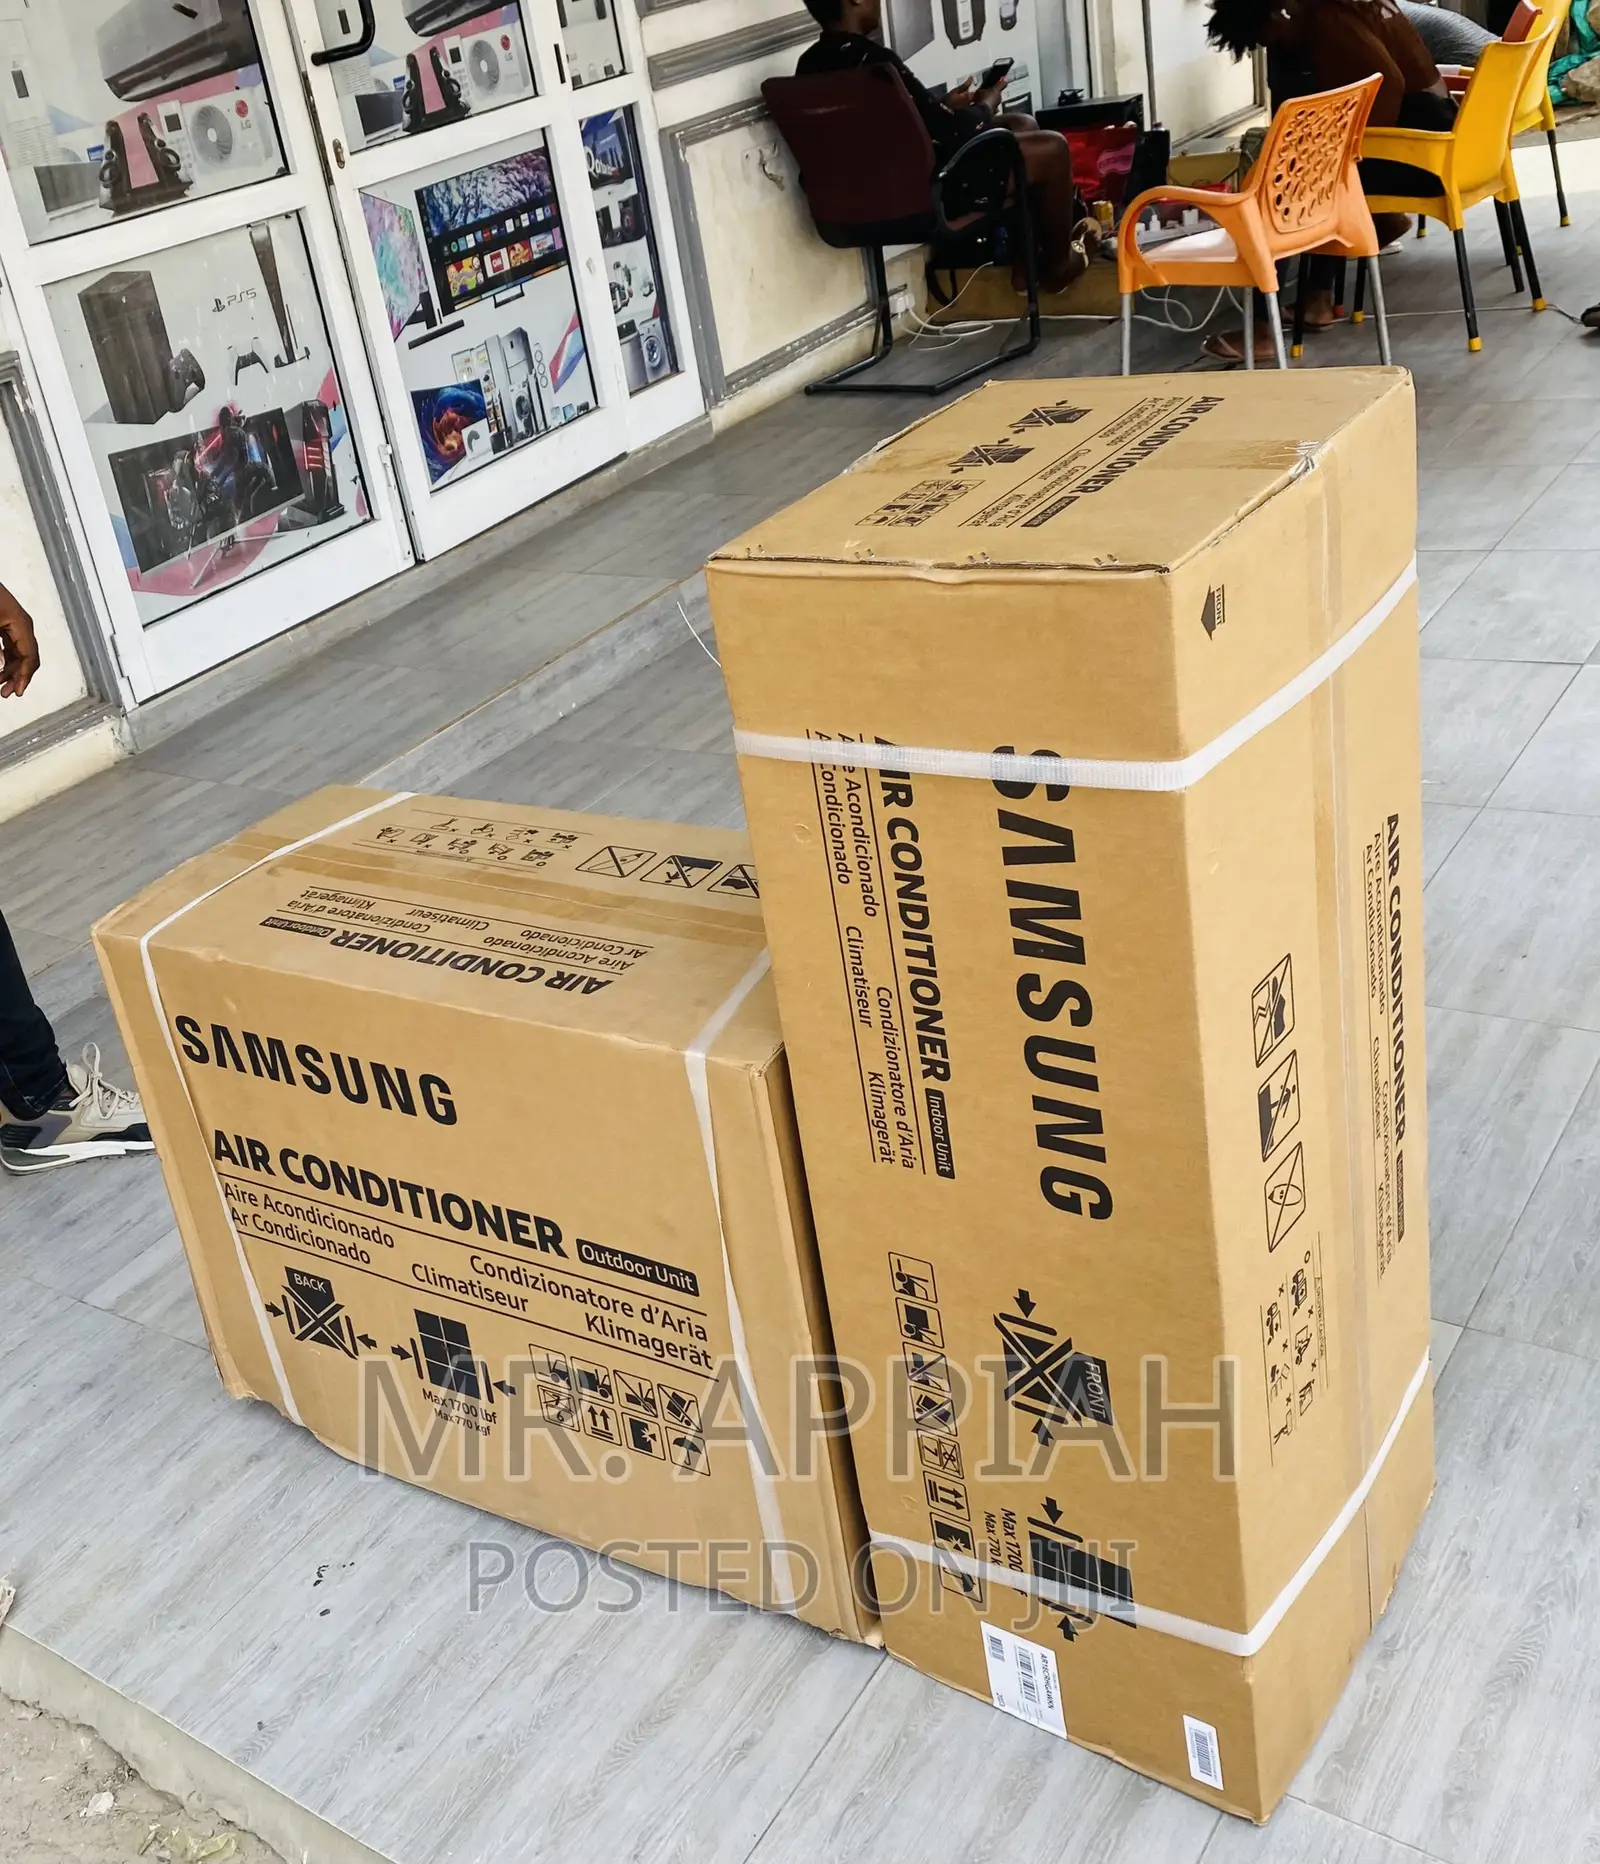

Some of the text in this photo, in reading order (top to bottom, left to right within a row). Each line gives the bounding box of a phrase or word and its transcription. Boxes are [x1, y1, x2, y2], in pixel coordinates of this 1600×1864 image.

[227, 288, 257, 306] PS5
[1180, 396, 1225, 415] AIR
[1069, 416, 1199, 494] CONDITIONER
[1387, 813, 1400, 886] AIR
[287, 900, 635, 970] Aire Acondicionado Condizionatore d'Aria
[300, 890, 647, 959] Ar Condicionado Climatiseur Klimagerät
[330, 930, 546, 983] CONDITIONER
[887, 822, 950, 1083] CONDITIONER
[1367, 867, 1377, 999] Condicionado
[1376, 877, 1385, 1015] Acondicionado
[545, 971, 614, 995] AIR
[845, 778, 877, 917] Acondicionado
[876, 986, 906, 1114] Condizionatore
[896, 1116, 914, 1170] d'Aria
[846, 925, 873, 1028] Climatiseur
[868, 1071, 895, 1165] Klimagerät
[1389, 886, 1406, 1149] CONDITIONER
[175, 1015, 458, 1126] SAMSUNG
[929, 1096, 947, 1142] Indoor
[936, 1145, 951, 1173] Unit
[214, 1129, 695, 1292] AIR CONDITIONER Outdoor Unit
[224, 1182, 708, 1342] Aire Acondicionado Condizionatore d'Aria
[231, 1206, 713, 1371] Ar Condicionado Climatiseur Klimagerät
[293, 1272, 327, 1295] BACK
[422, 1388, 498, 1424] Max 1700 lbf
[434, 1408, 491, 1437] Max 770 kgf
[1085, 1361, 1106, 1419] FRONT
[984, 1511, 997, 1536] Max
[988, 1536, 1001, 1558] 770
[1001, 1507, 1017, 1540] Max
